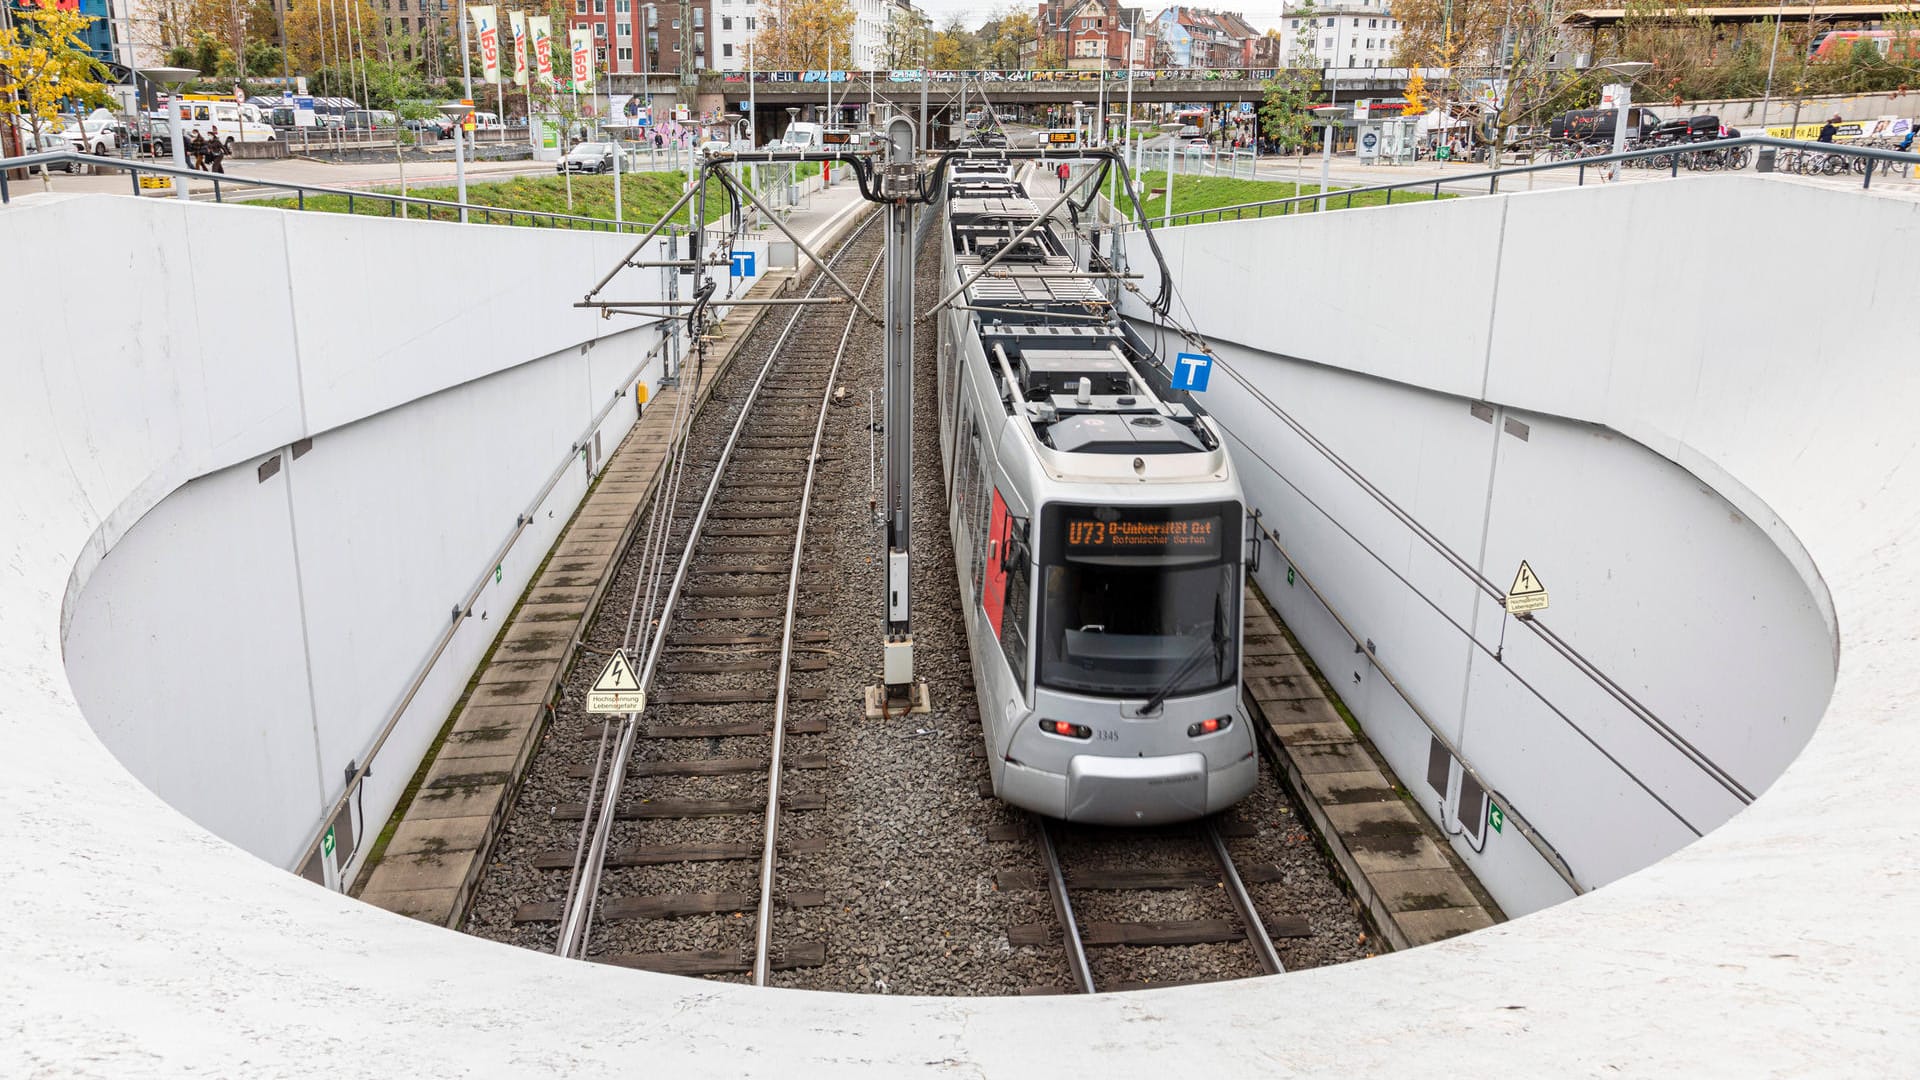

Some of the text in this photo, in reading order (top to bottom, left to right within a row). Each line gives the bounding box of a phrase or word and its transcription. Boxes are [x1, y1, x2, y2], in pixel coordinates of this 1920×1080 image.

[733, 254, 752, 277] T
[1181, 358, 1207, 386] T
[1069, 521, 1105, 544] U73
[1191, 521, 1211, 534] Ost
[1096, 729, 1119, 741] 3345
